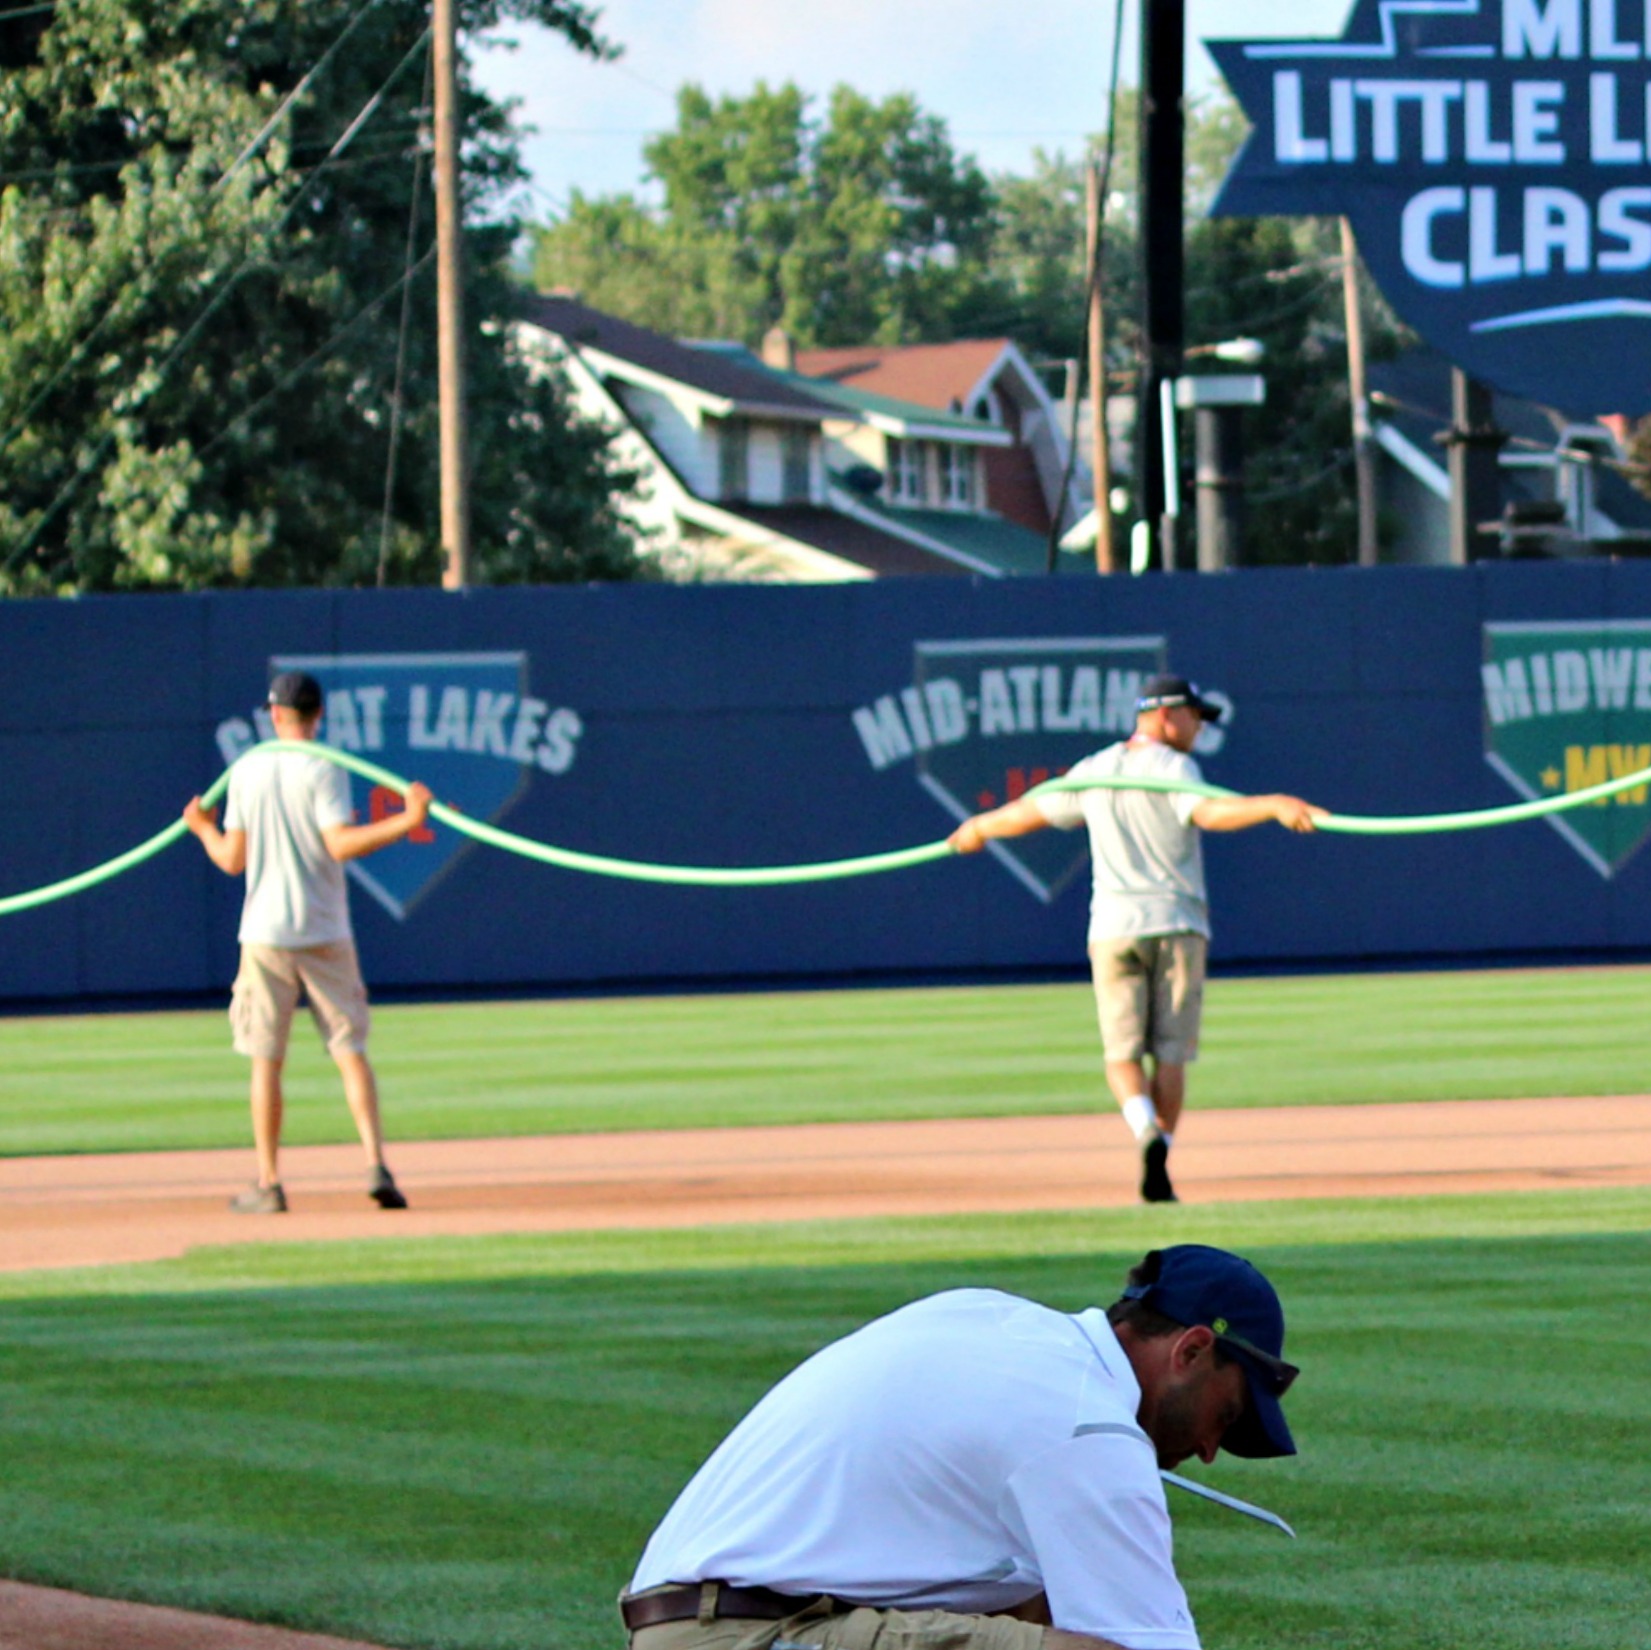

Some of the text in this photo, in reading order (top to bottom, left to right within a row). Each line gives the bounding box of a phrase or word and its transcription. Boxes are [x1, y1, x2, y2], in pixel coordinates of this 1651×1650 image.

[1272, 70, 1566, 164] LITTLE
[214, 684, 584, 776] GAT LAKES
[852, 665, 1235, 770] MID-ATLANC
